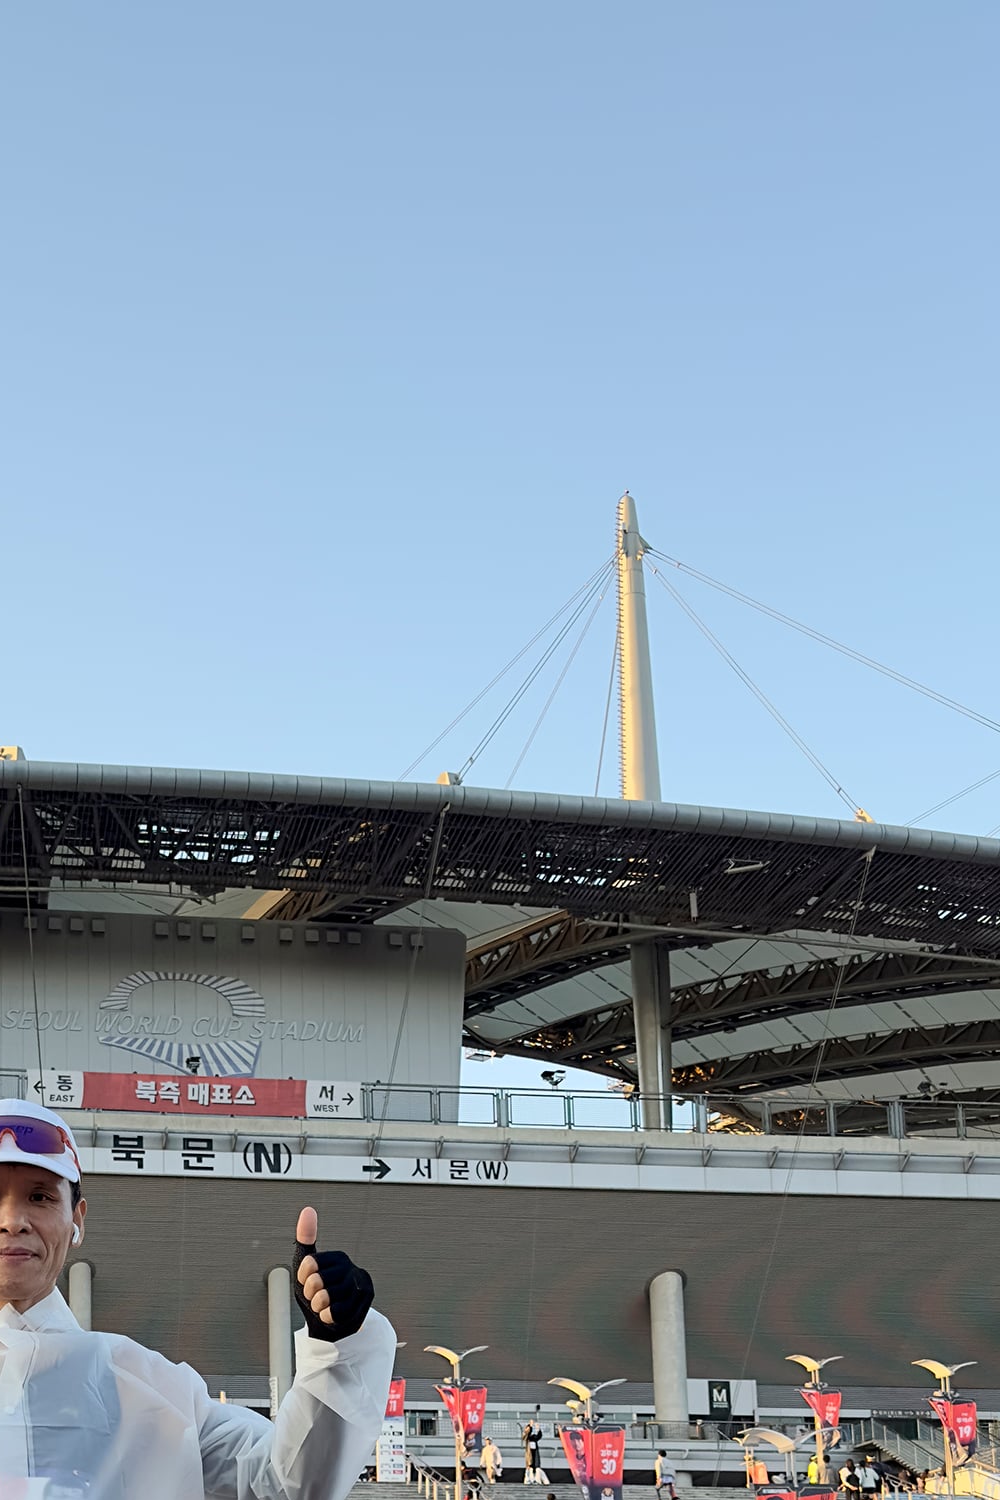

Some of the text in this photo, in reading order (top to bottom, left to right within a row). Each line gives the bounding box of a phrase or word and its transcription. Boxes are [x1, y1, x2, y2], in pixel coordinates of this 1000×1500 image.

[1, 1008, 364, 1042] SEOUL WORLD CUP STADIUM
[56, 1075, 72, 1093] 동
[49, 1094, 75, 1103] EAST
[134, 1080, 256, 1107] 북측 매표소
[319, 1085, 335, 1101] 서
[313, 1104, 340, 1113] WEST
[712, 1388, 727, 1402] M
[467, 1411, 479, 1424] 16
[958, 1426, 972, 1439] 19
[601, 1458, 617, 1475] 30
